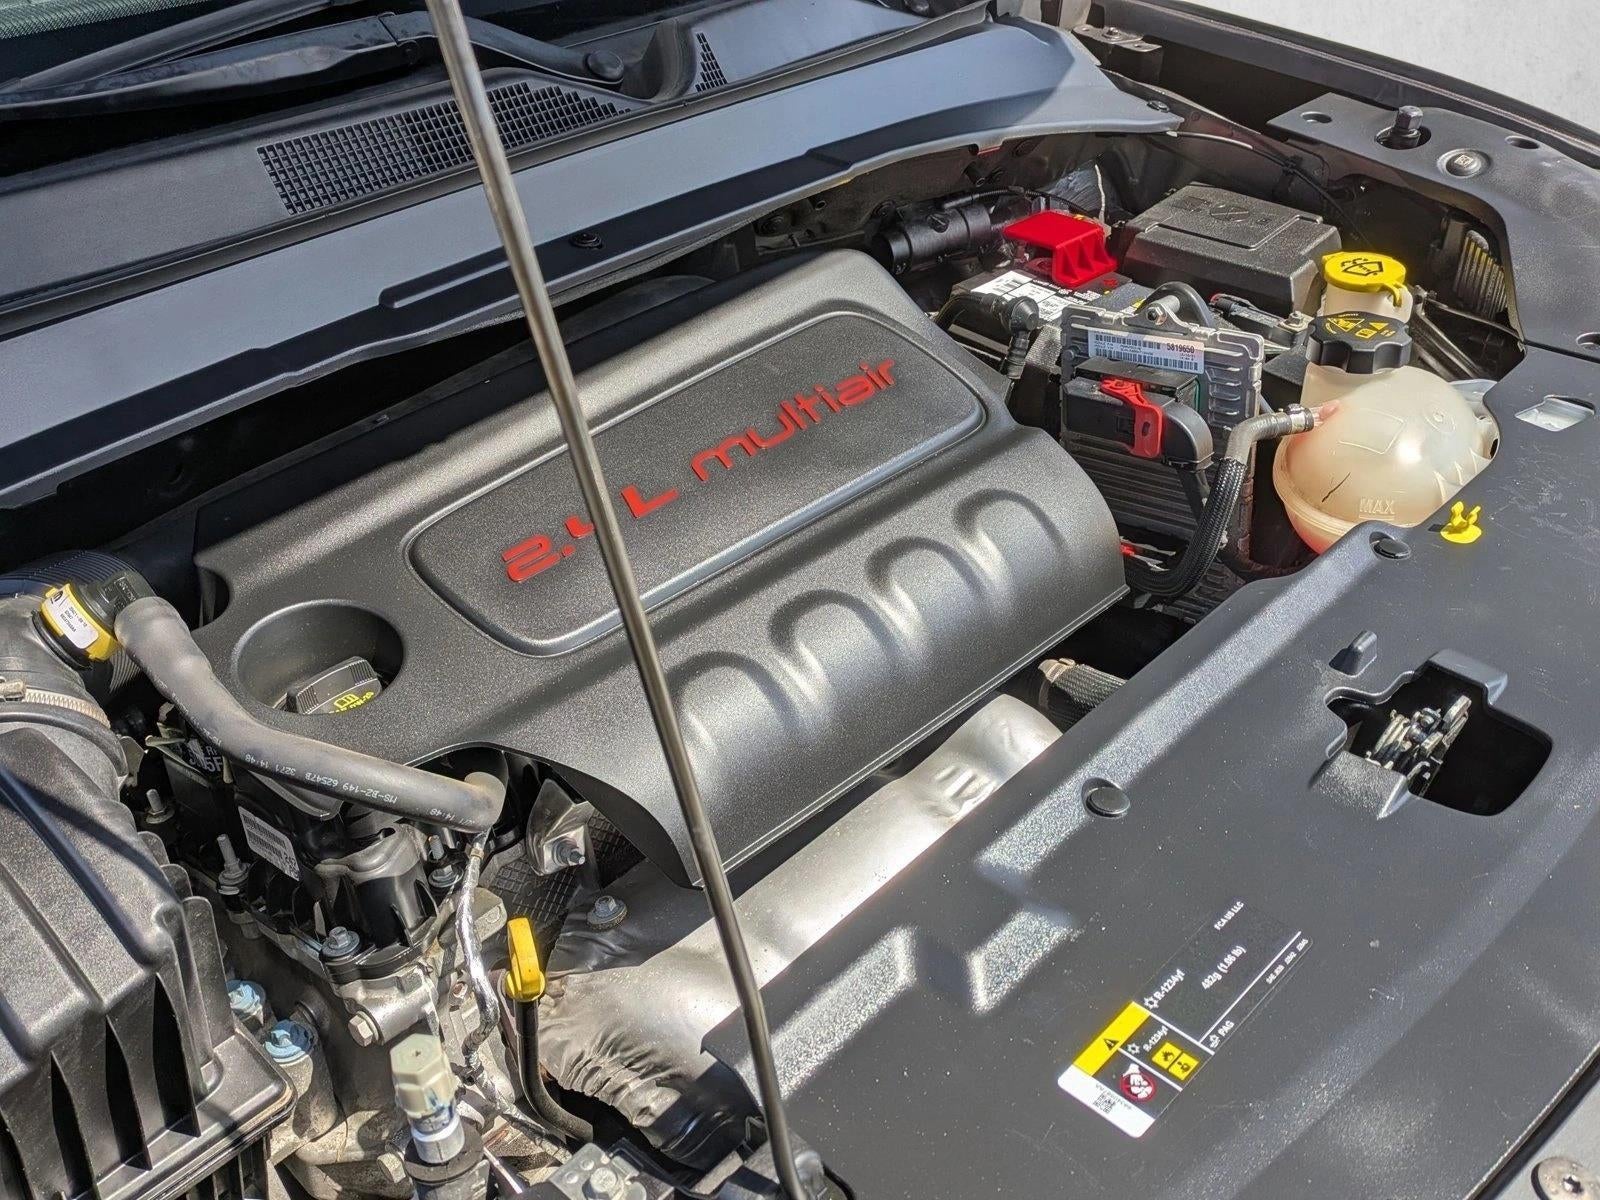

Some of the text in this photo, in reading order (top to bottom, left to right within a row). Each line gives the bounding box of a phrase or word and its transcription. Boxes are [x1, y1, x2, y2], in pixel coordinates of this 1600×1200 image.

[689, 357, 896, 483] multiair
[1359, 496, 1395, 514] MAX
[275, 764, 296, 776] 3271
[1213, 901, 1244, 931] FCA US LLC
[1153, 968, 1185, 1001] R-1234yf
[1201, 971, 1223, 990] 482g
[1217, 1020, 1235, 1037] PAG
